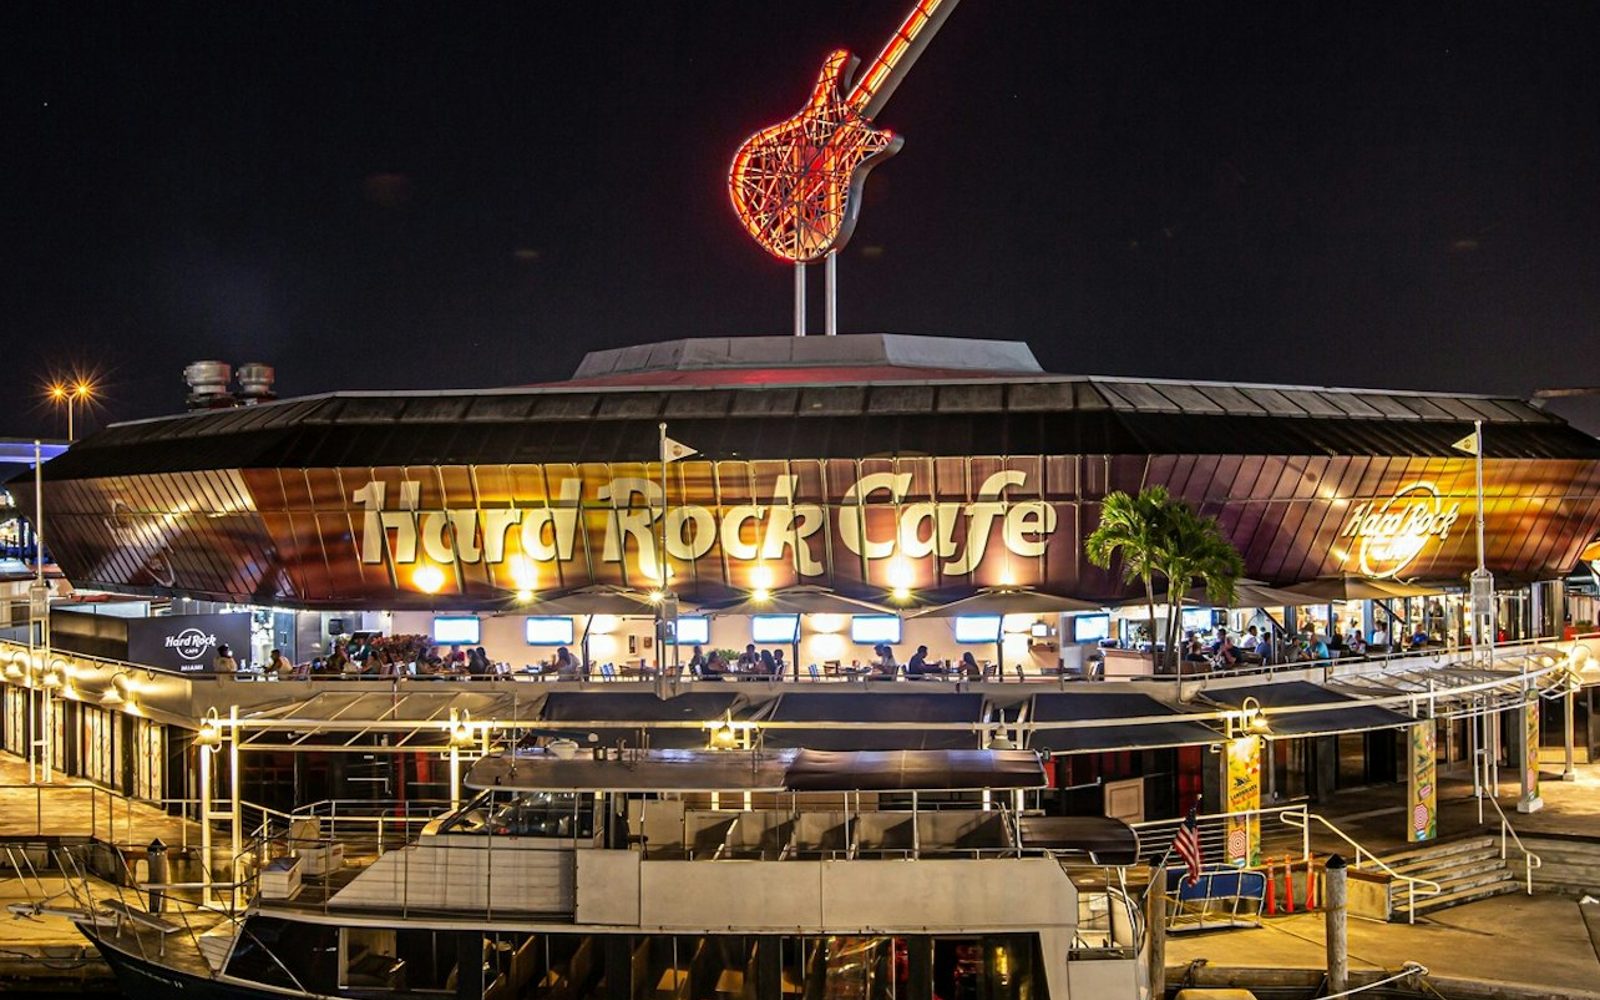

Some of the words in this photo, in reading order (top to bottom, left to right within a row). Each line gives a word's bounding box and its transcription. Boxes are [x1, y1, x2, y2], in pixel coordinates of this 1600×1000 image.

[353, 478, 582, 564] Hard
[597, 474, 825, 580] Rock
[838, 470, 1057, 576] Cafe
[1341, 503, 1410, 537] Hard
[1401, 502, 1460, 540] Rock
[165, 636, 191, 647] Hard
[192, 634, 216, 648] Rock
